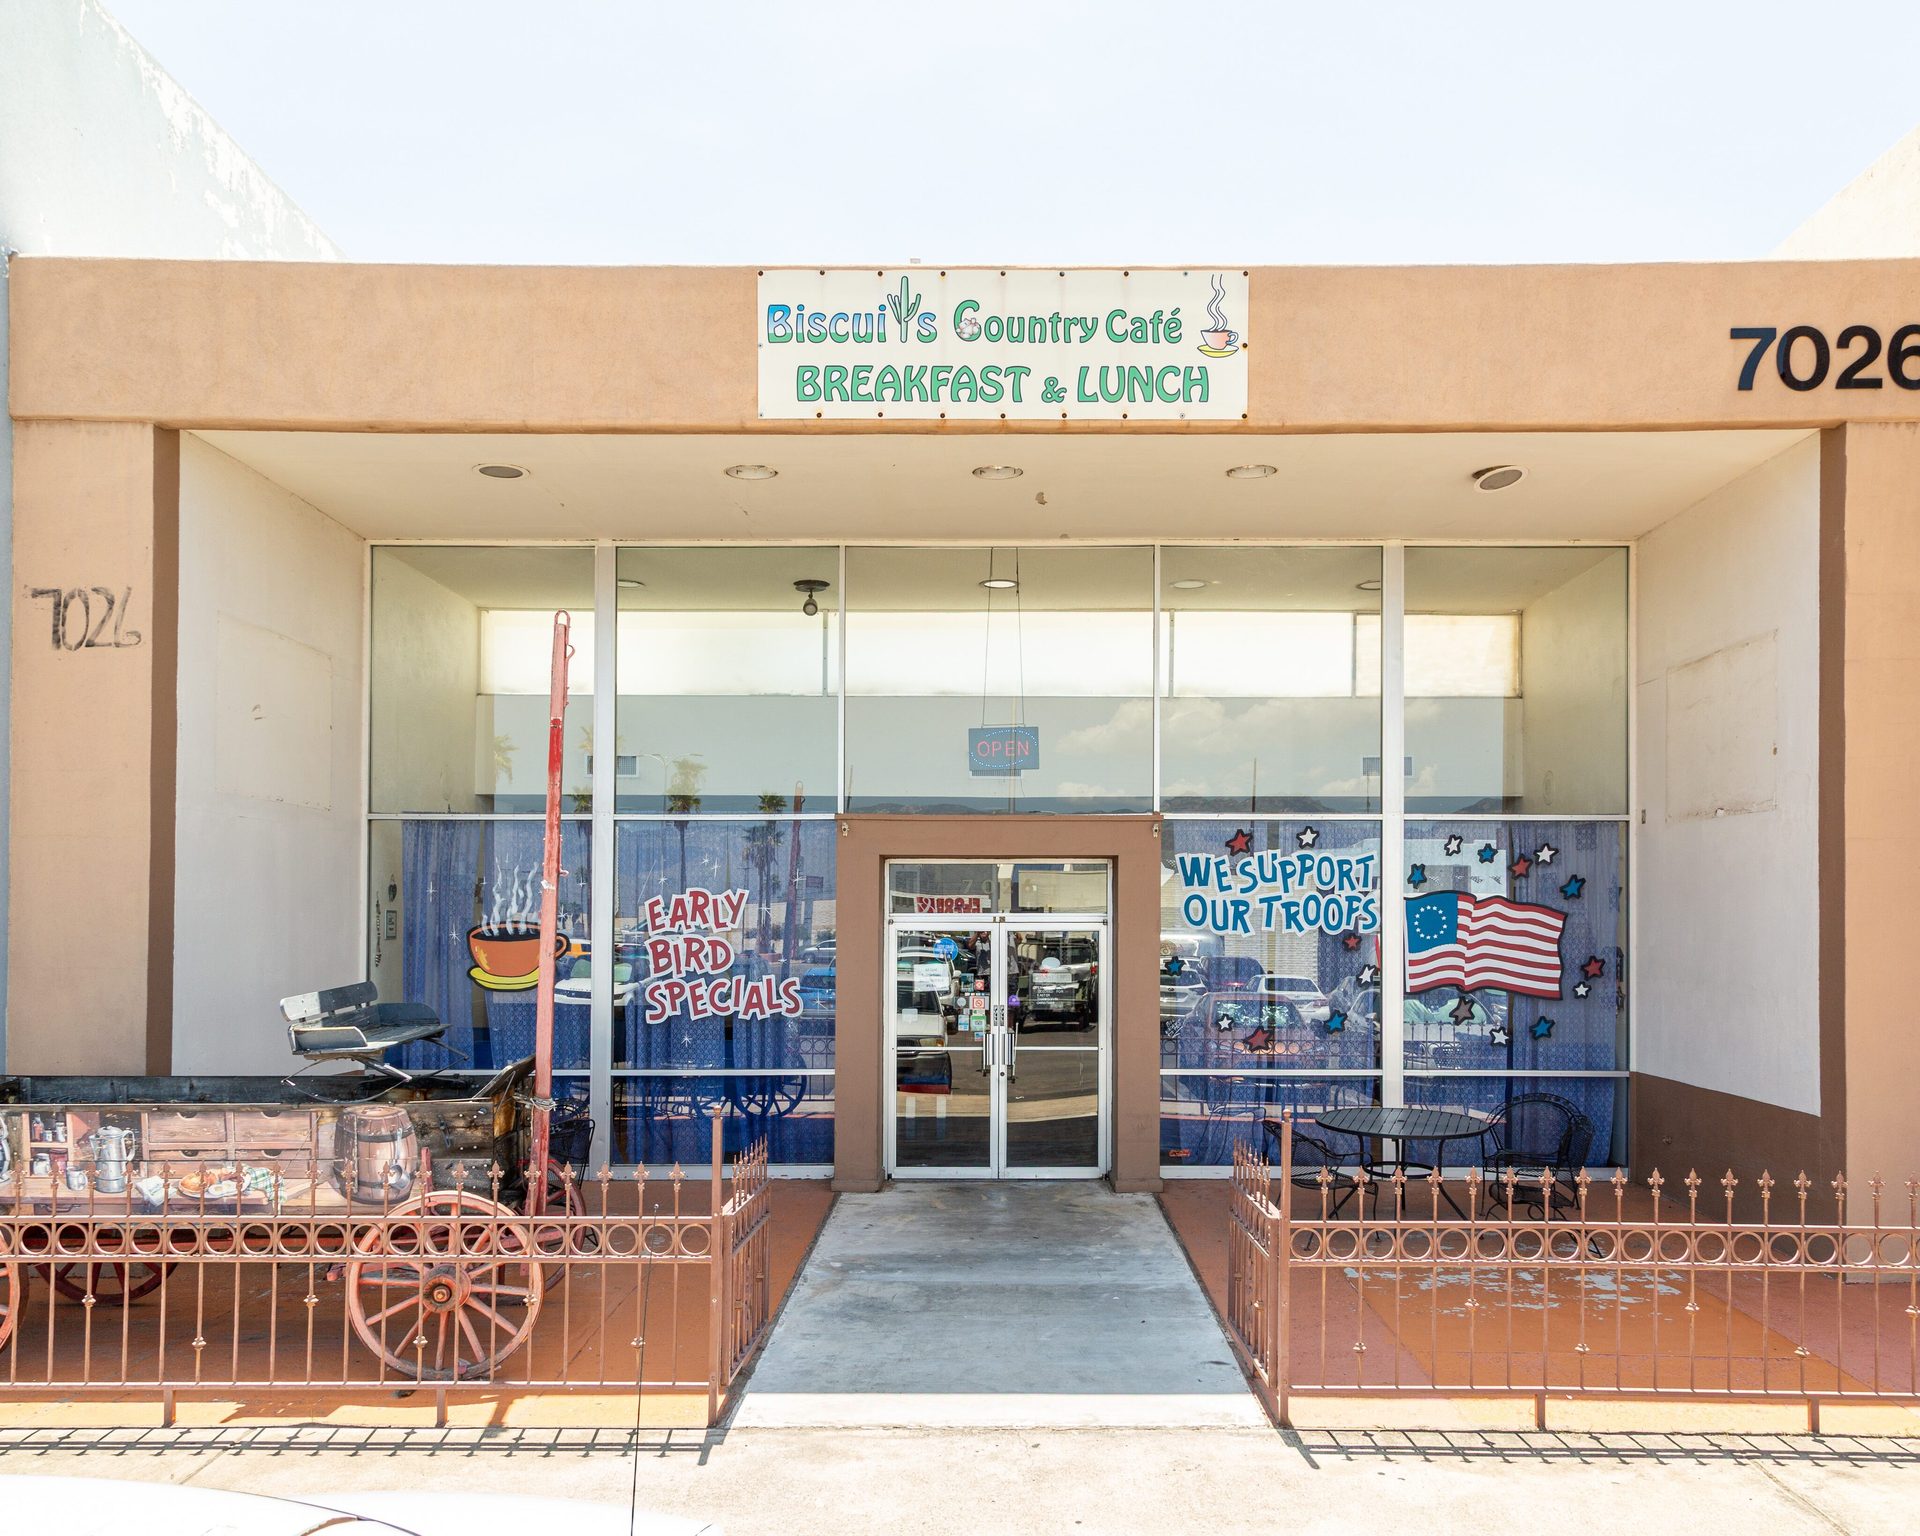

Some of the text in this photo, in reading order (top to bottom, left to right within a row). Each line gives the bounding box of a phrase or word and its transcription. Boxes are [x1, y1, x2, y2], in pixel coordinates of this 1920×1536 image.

[953, 300, 1099, 344] Country
[1105, 307, 1183, 344] Café
[1730, 324, 1920, 391] 7026
[796, 365, 1210, 404] BREAKFAST & LUNCH
[30, 587, 142, 650] 7026
[976, 740, 1030, 757] OPEN
[1179, 852, 1375, 893] WE SUPPORT
[648, 890, 746, 932] EARLY
[1183, 893, 1252, 934] OUR
[648, 937, 732, 976] BIRD
[647, 978, 801, 1021] SPECIALS
